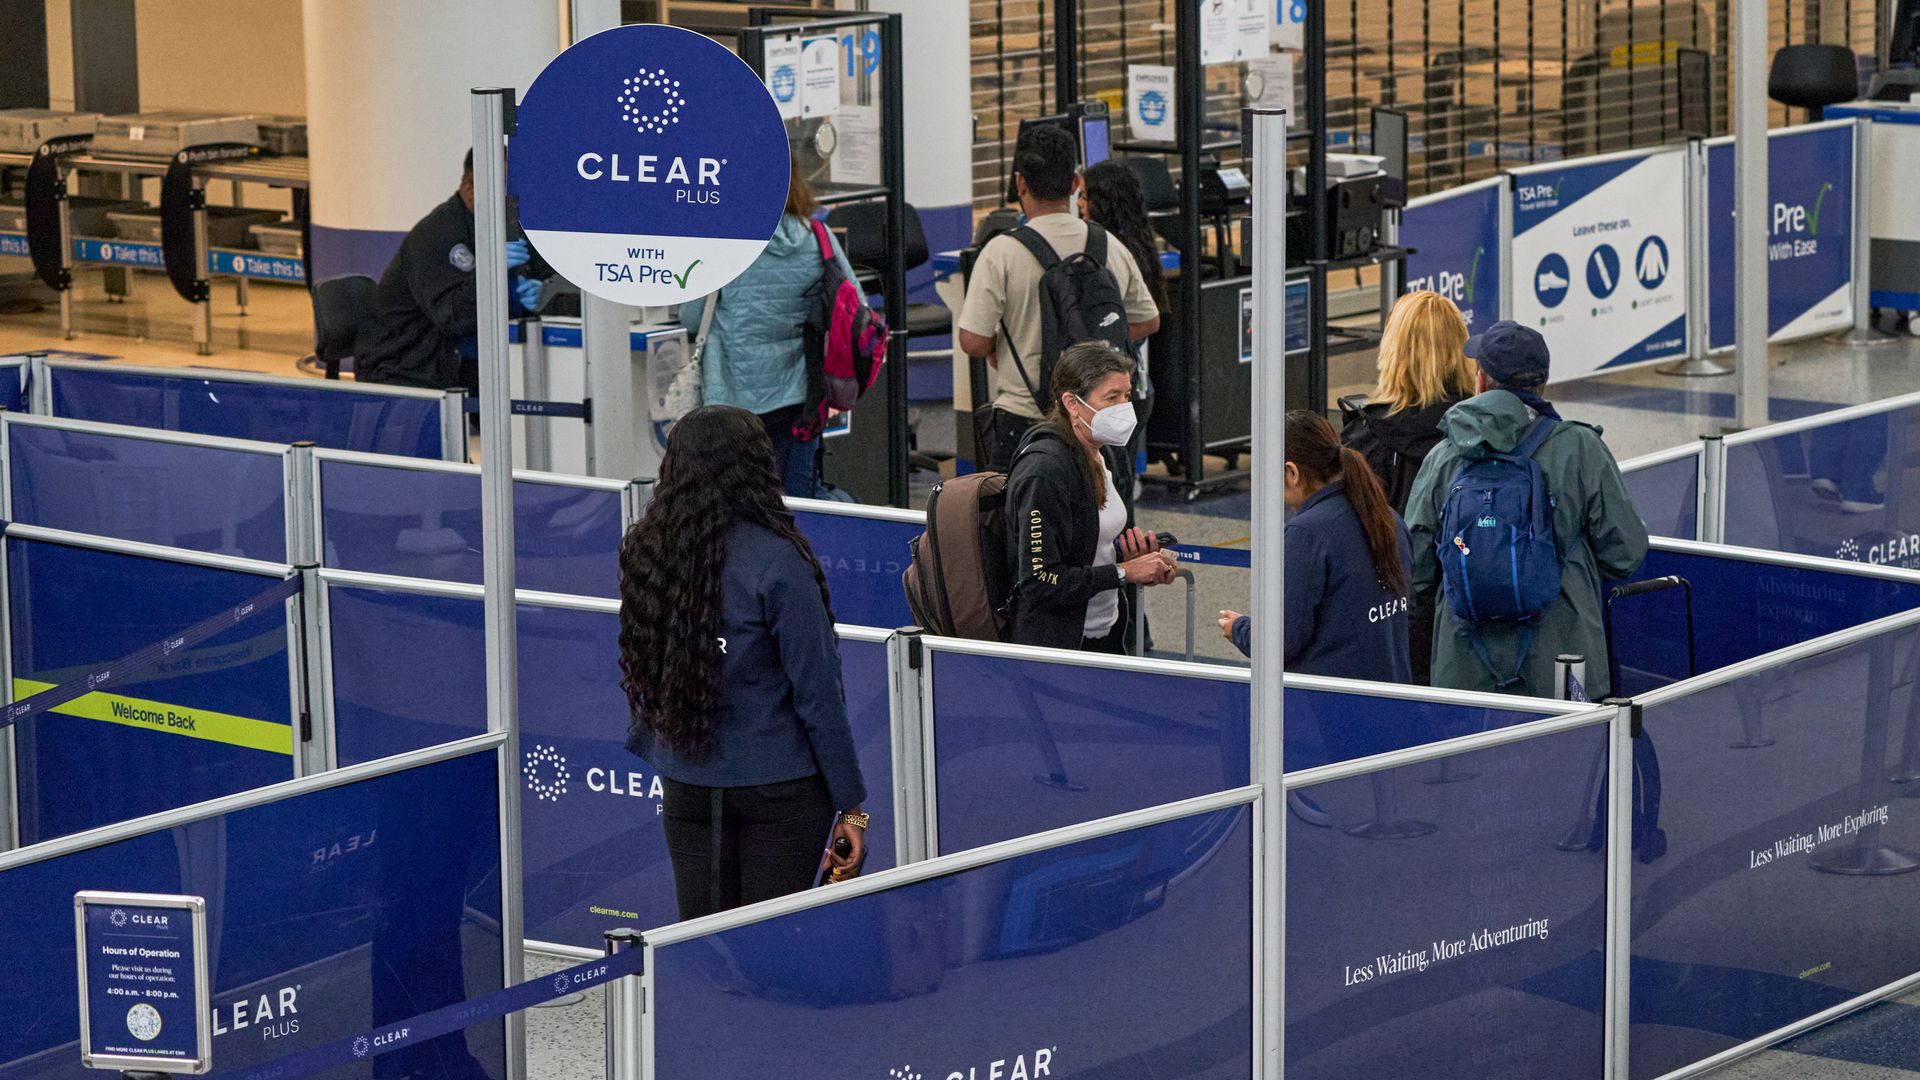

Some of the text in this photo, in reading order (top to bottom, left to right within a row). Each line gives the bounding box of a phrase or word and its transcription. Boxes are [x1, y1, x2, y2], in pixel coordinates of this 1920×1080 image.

[841, 31, 881, 78] 19
[676, 189, 720, 205] PLUS
[1518, 184, 1553, 202] TSA Pre
[1773, 203, 1806, 235] Pre
[1573, 224, 1596, 237] Leave
[1598, 220, 1618, 232] these
[113, 245, 137, 262] Take
[138, 247, 158, 264] this
[626, 247, 665, 260] WITH
[1794, 239, 1818, 257] Ease
[247, 258, 271, 275] Take
[272, 260, 293, 277] this
[594, 262, 673, 285] TSA Pre
[1439, 270, 1465, 301] Pre
[516, 404, 544, 413] CLEAR
[1030, 509, 1042, 554] GOLDEN
[1868, 534, 1920, 565] CLEAR
[1368, 596, 1407, 623] CLEAR
[170, 636, 184, 649] CLEAR
[96, 670, 110, 683] CLEAR
[15, 702, 31, 716] CLEAR
[111, 700, 196, 732] Welcome Back
[586, 767, 664, 800] CLEA
[1750, 804, 1889, 870] Less Waiting, More Exploring
[131, 914, 169, 925] CLEAR
[589, 904, 639, 920] clearme.com
[102, 946, 180, 958] Hours of Operation
[1344, 917, 1549, 987] Less Waiting, More Adventuring
[111, 963, 130, 971] Please
[152, 966, 172, 976] during
[120, 972, 137, 980] hours
[573, 966, 607, 984] CLEAR
[107, 987, 124, 995] 4:00
[125, 989, 140, 997] a.m.
[146, 989, 162, 997] 8:00
[163, 991, 179, 999] p.m.
[212, 985, 298, 1037] LEAR
[263, 1019, 300, 1041] PLUS
[373, 1028, 409, 1047] CLEAR
